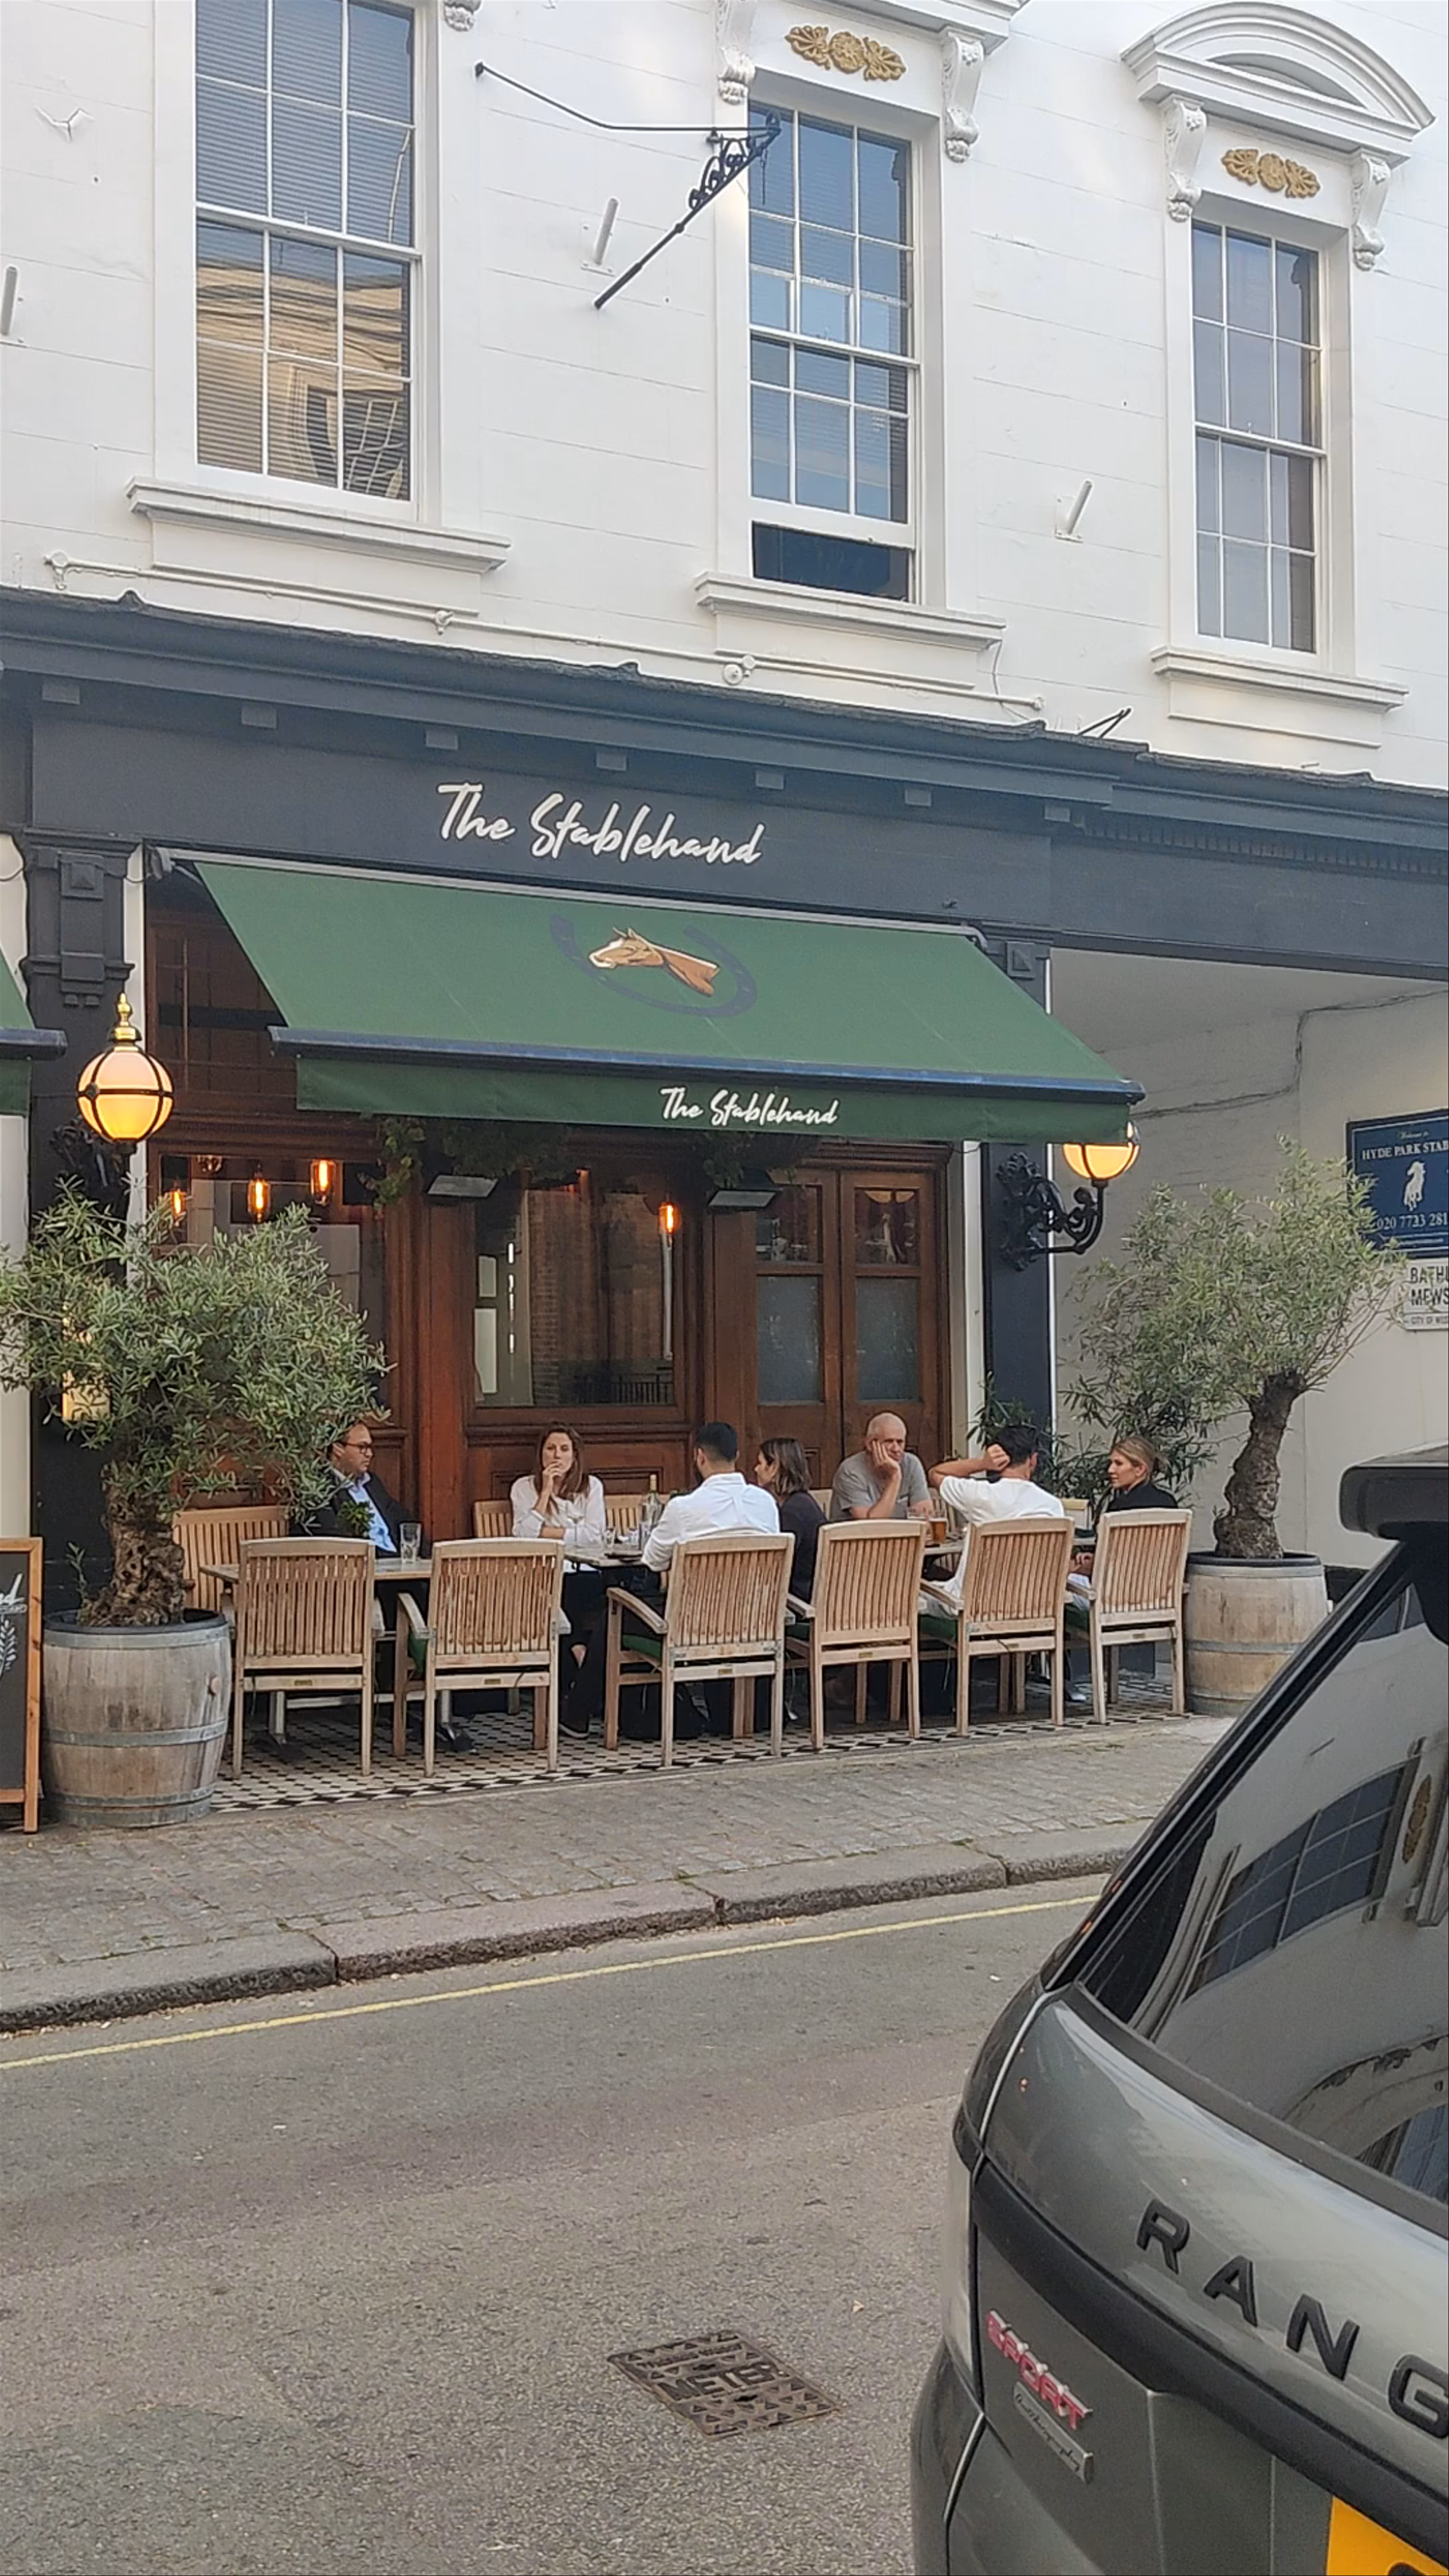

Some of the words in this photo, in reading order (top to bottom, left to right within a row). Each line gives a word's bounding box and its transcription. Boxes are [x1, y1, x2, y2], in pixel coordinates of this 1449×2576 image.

[438, 782, 515, 840] The
[531, 793, 765, 864] Stablehand
[660, 1087, 703, 1119] The
[710, 1089, 839, 1126] Stablehand
[1362, 1147, 1392, 1160] HYDE
[1394, 1144, 1421, 1156] PARK
[1422, 1140, 1449, 1153] STAB
[1377, 1216, 1396, 1230] 020
[1137, 2198, 1449, 2440] RANG
[987, 2310, 1093, 2430] SPORT
